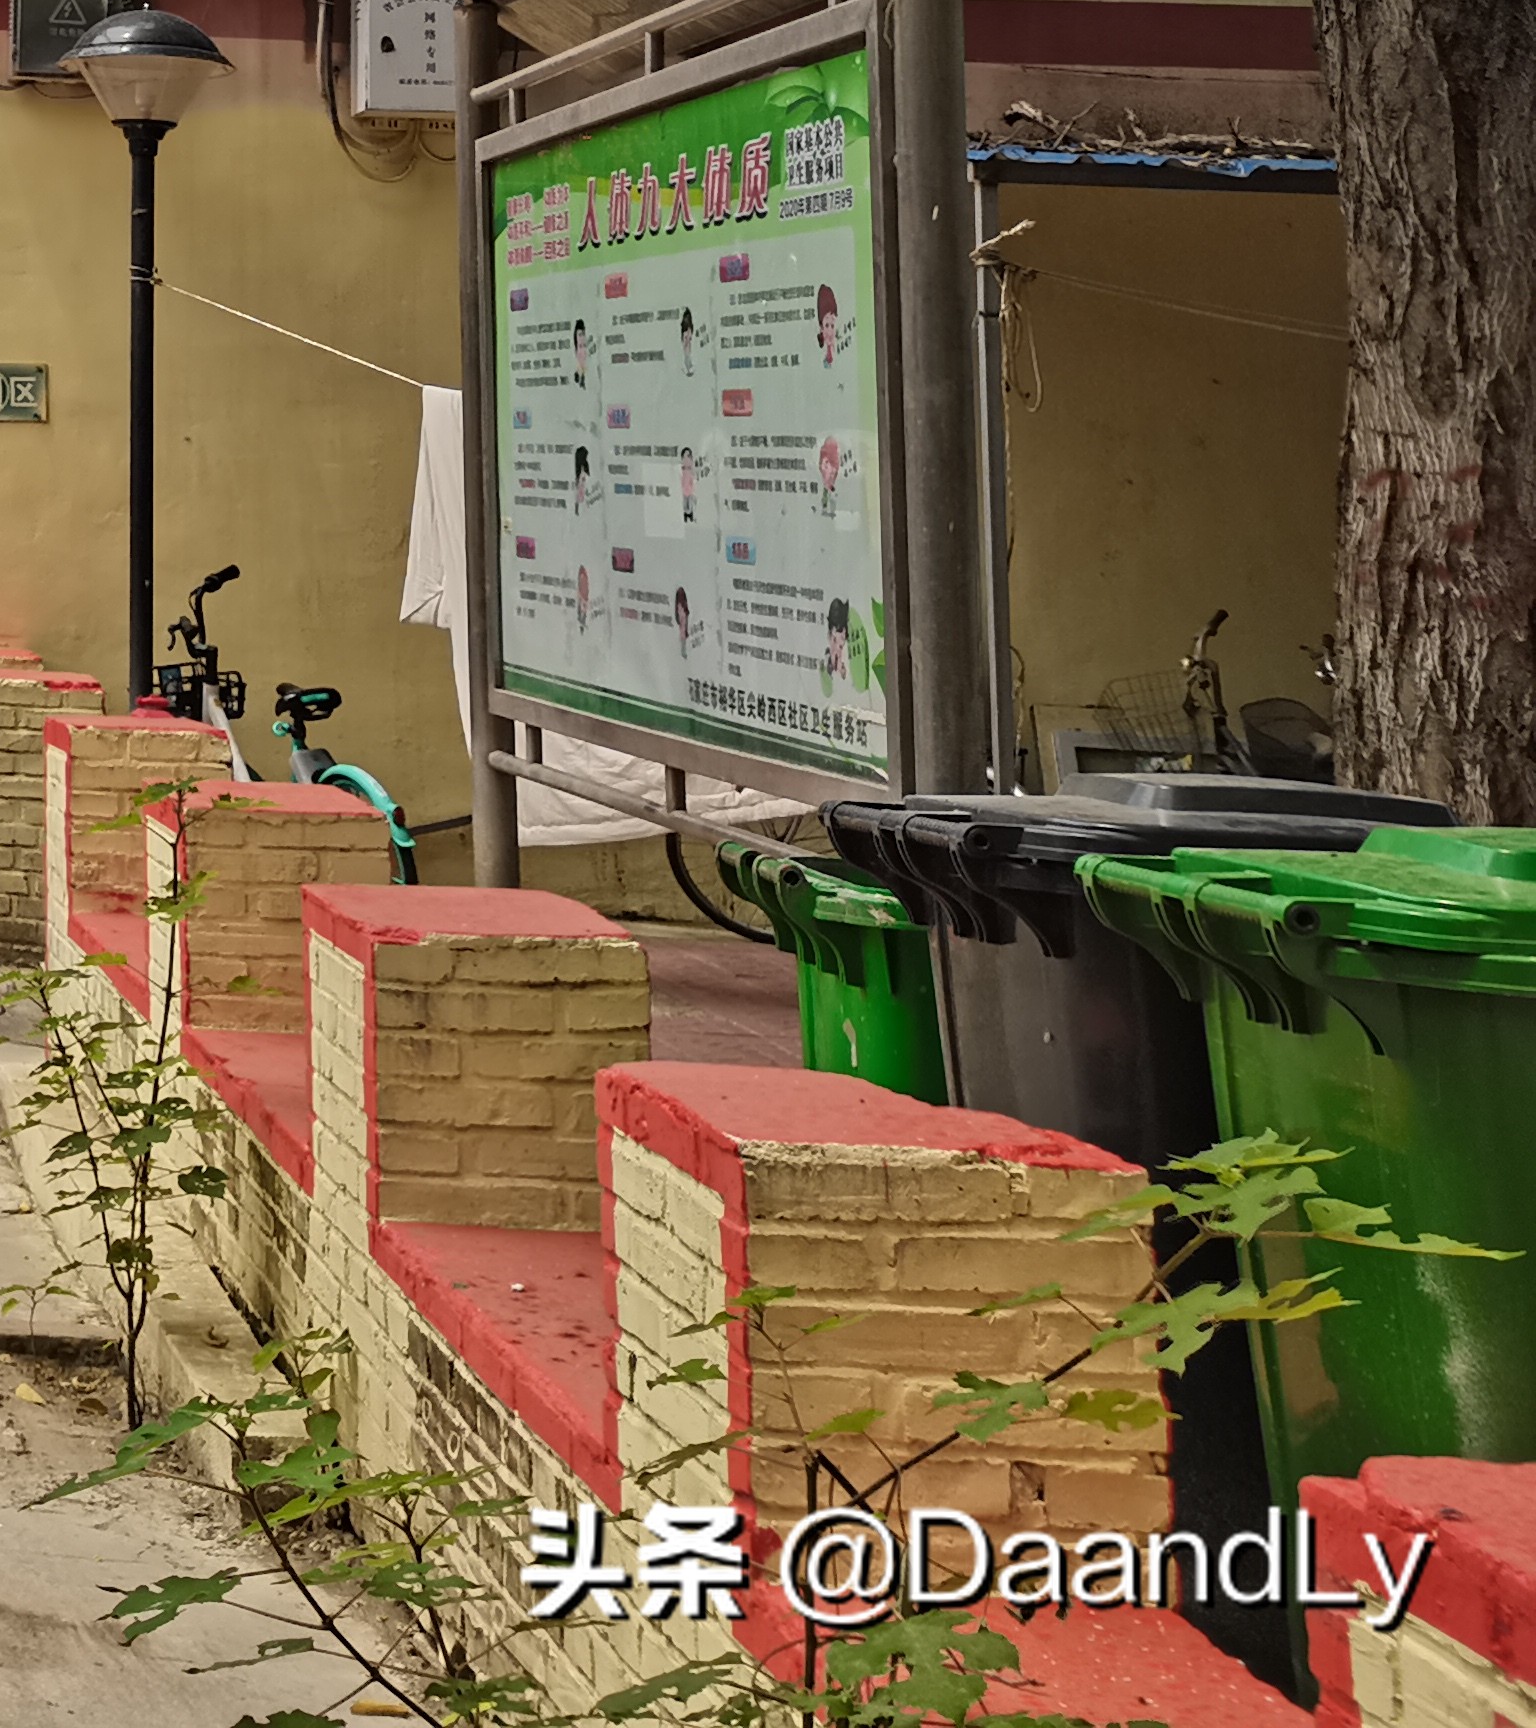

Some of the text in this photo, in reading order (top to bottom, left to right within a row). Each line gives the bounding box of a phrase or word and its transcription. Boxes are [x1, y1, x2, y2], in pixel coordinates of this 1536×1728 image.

[578, 131, 771, 251] 人体九大体质
